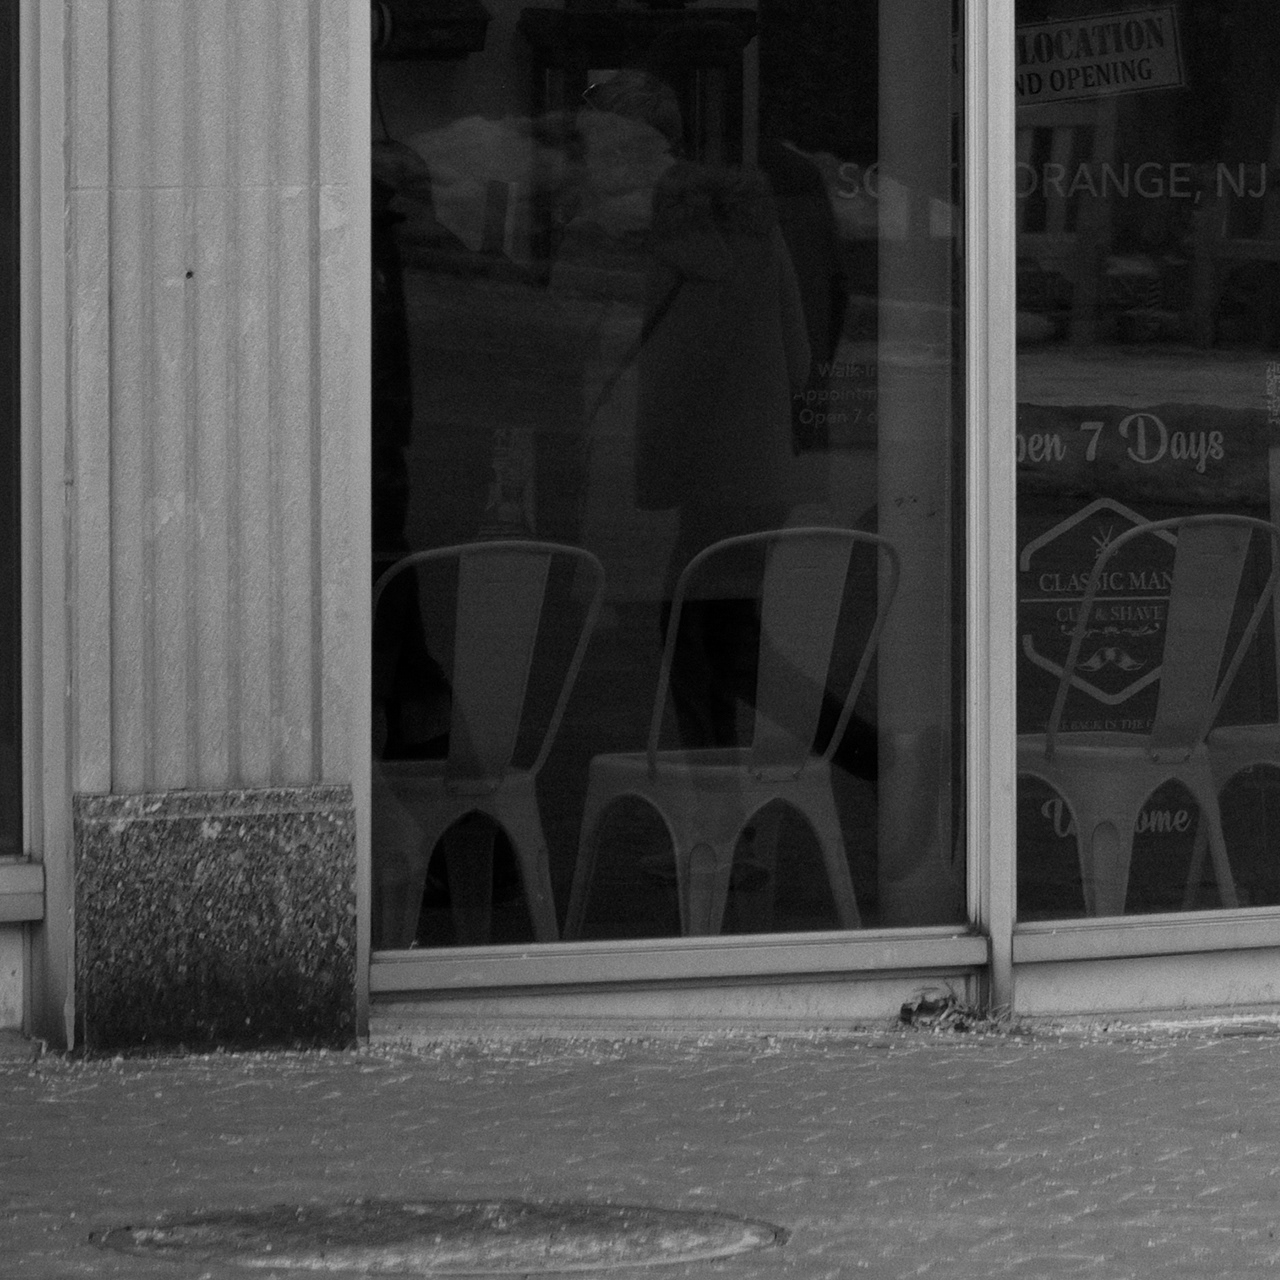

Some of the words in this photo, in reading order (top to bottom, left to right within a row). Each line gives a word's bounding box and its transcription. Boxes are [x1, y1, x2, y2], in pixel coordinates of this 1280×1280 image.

[1016, 17, 1165, 67] LOCATION
[1049, 57, 1153, 93] OPENING
[1216, 162, 1268, 199] NJ
[1080, 421, 1105, 462] 7
[1118, 412, 1225, 474] Days
[1110, 605, 1165, 621] SHAVE
